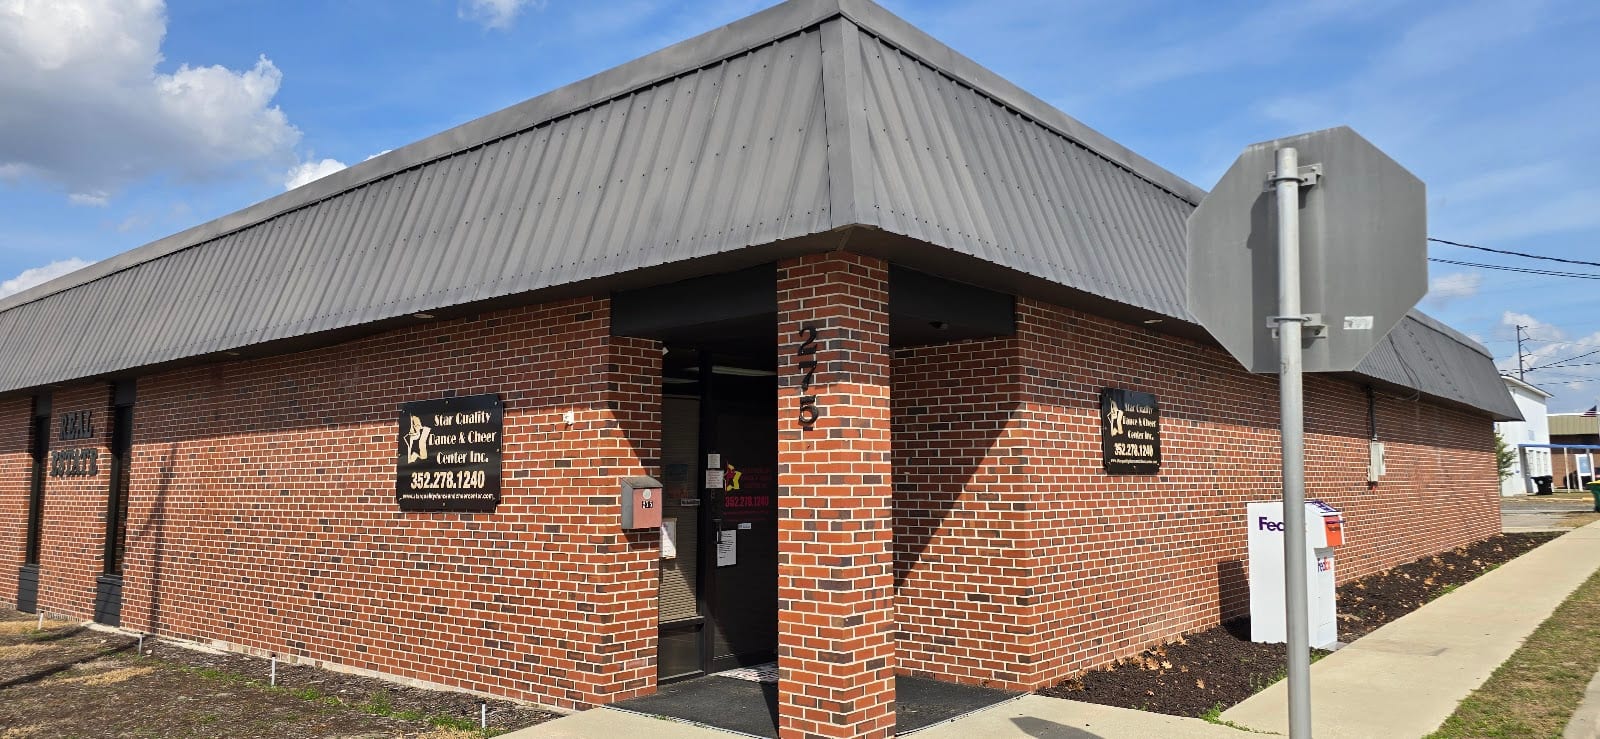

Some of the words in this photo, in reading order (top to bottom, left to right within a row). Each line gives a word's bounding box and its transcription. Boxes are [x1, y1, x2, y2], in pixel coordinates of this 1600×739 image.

[798, 325, 819, 426] 275
[60, 411, 92, 440] REAL
[434, 414, 454, 427] Star
[455, 410, 492, 426] Quality
[1123, 415, 1138, 426] Dance
[1143, 417, 1157, 428] Cheer
[428, 433, 457, 446] Dance
[458, 431, 466, 444] &
[467, 430, 497, 444] Cheer
[1127, 430, 1144, 440] Center
[436, 451, 468, 465] Center
[470, 450, 489, 463] Inc.
[1114, 443, 1154, 457] 352.278.1240
[50, 448, 98, 478] ESTATE
[410, 470, 486, 490] 352.278.1240
